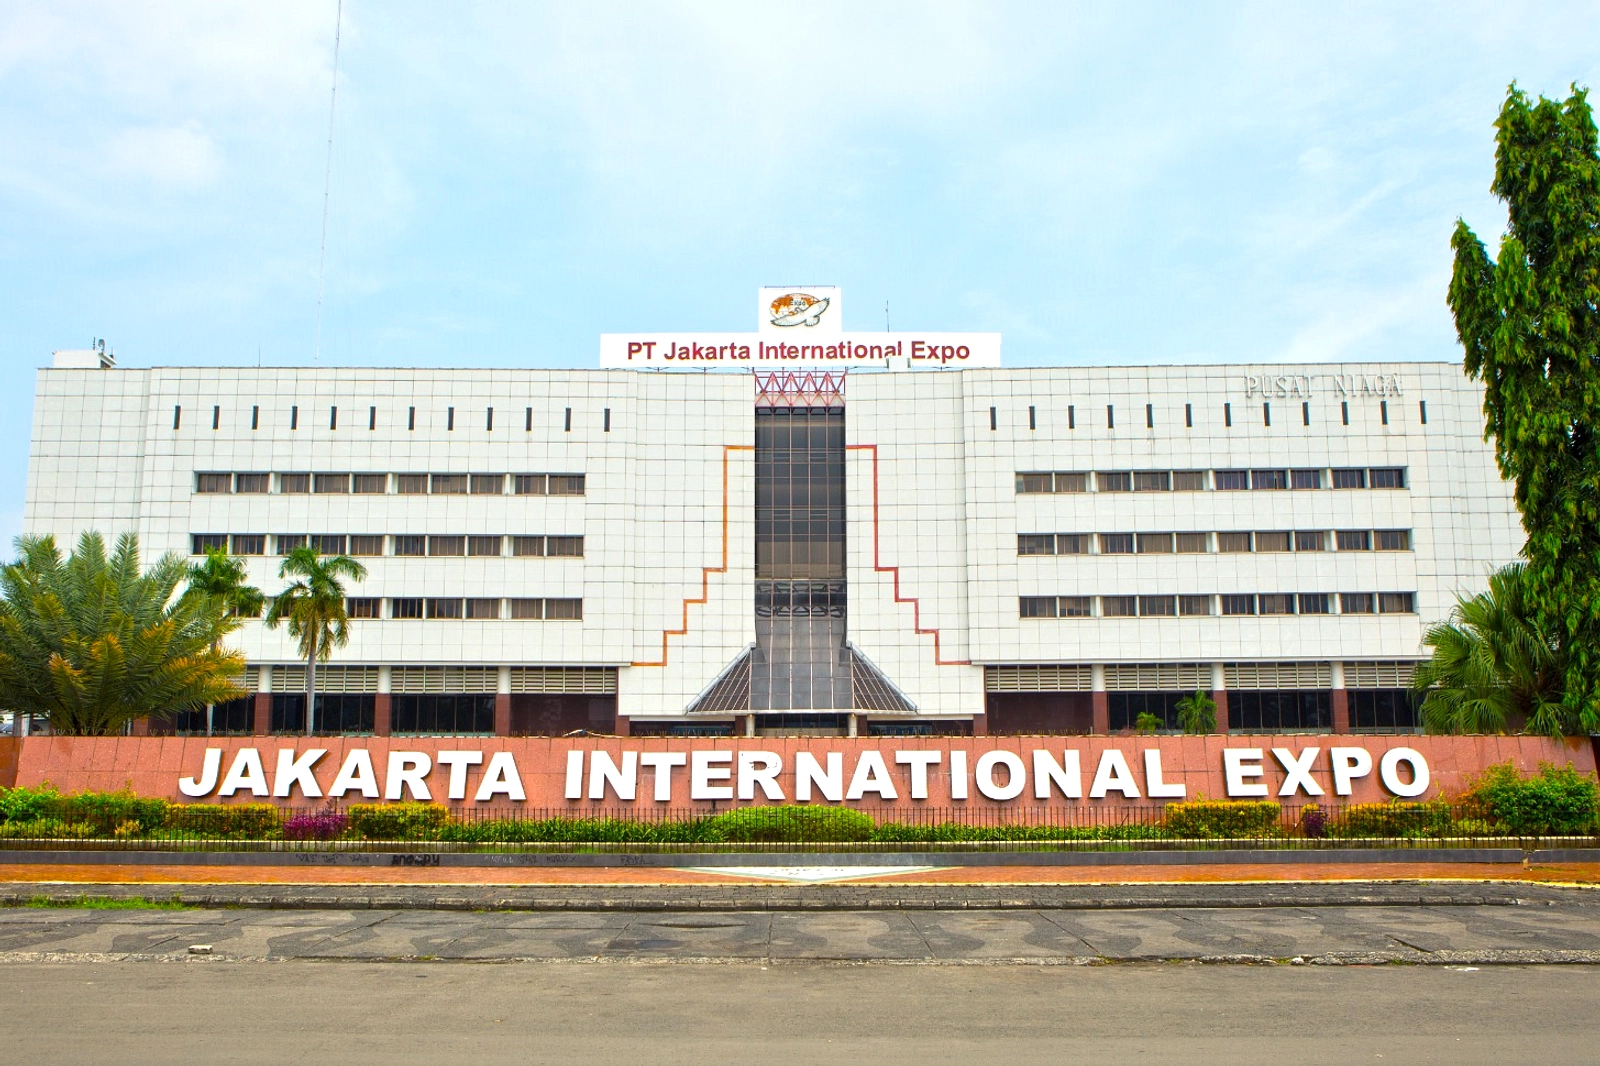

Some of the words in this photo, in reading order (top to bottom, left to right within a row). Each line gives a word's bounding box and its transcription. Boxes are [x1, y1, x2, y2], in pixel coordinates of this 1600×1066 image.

[628, 342, 657, 360] PT
[664, 342, 750, 361] Jakarta
[759, 342, 902, 360] International
[911, 341, 970, 364] Expo
[1245, 375, 1315, 399] PUSAT
[1333, 373, 1404, 398] NIAGA
[179, 748, 527, 802] JAKARTA
[564, 749, 1188, 803] INTERNATIONAL
[1223, 746, 1432, 799] EXPO
